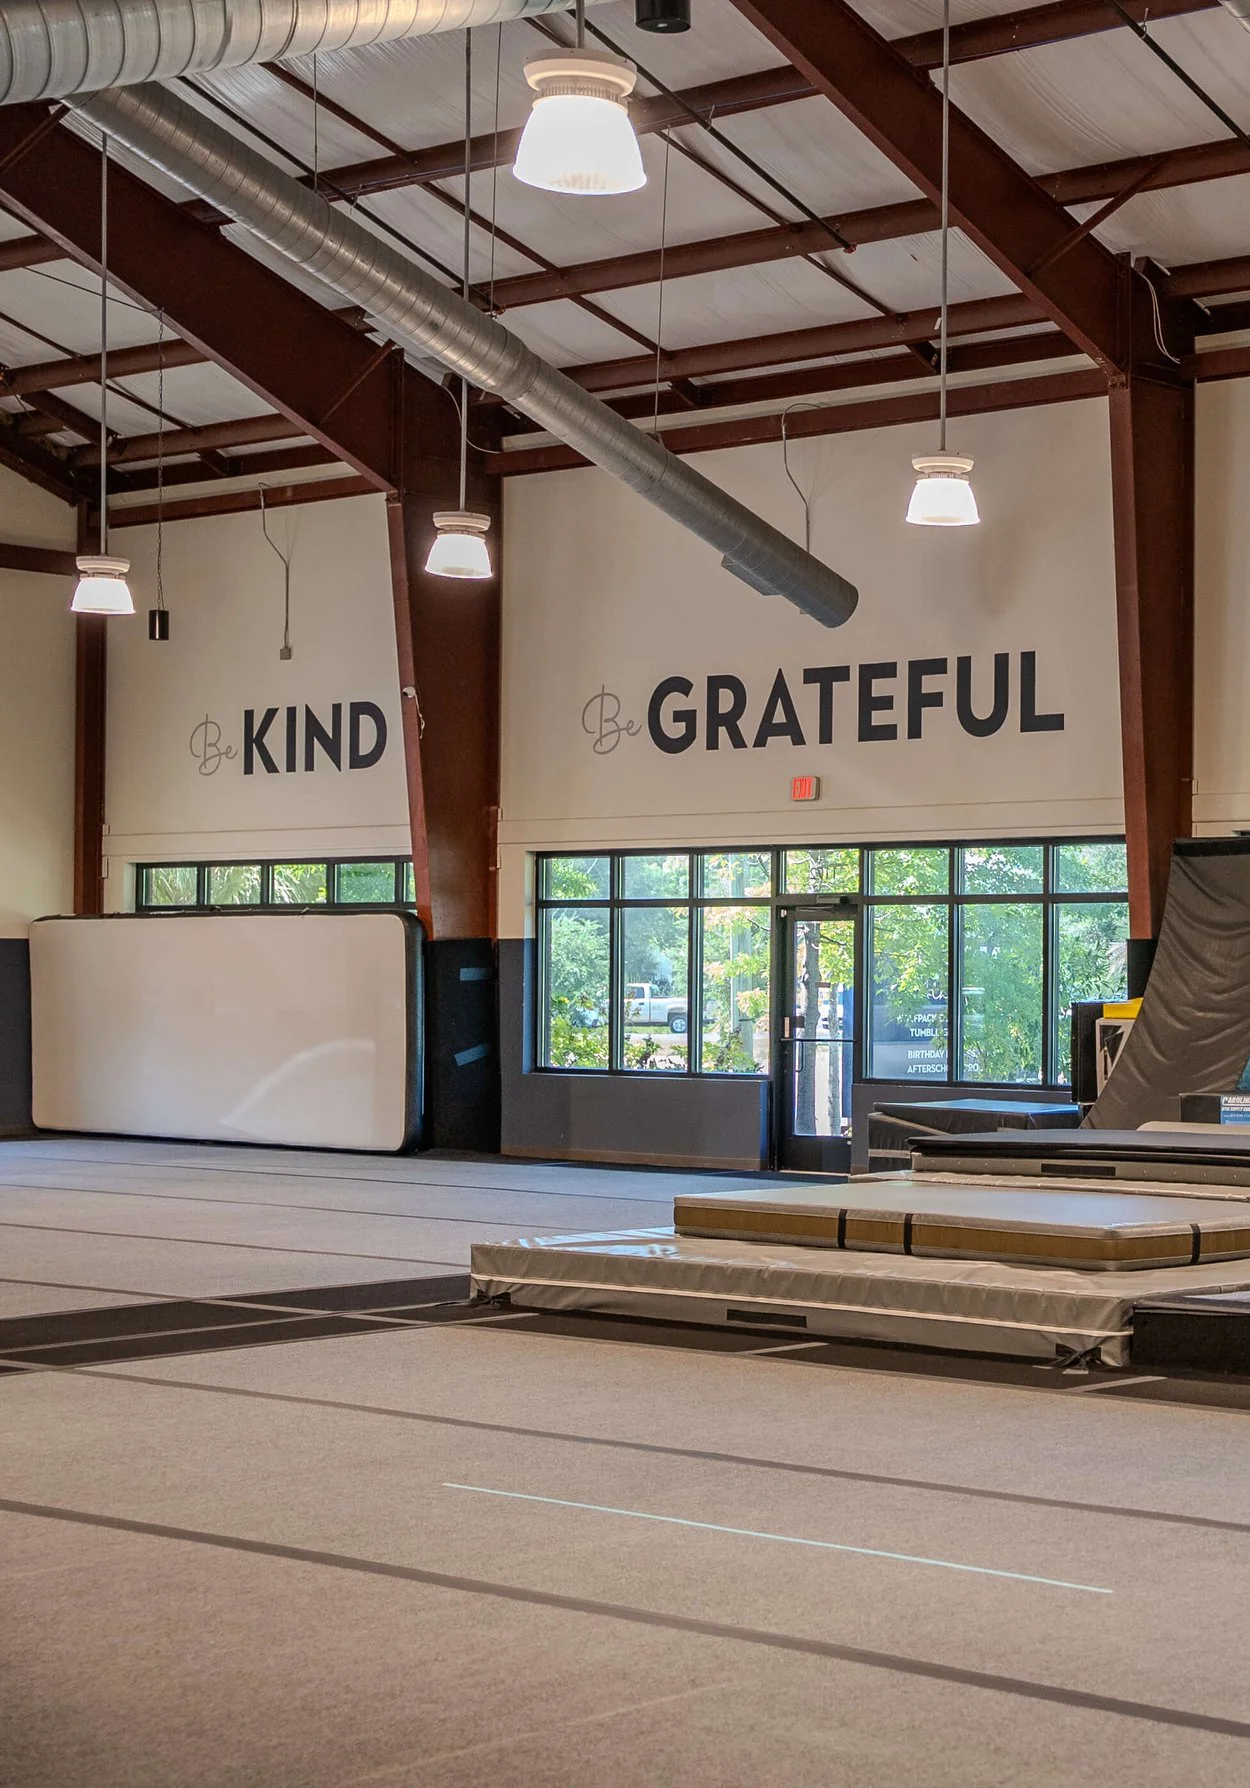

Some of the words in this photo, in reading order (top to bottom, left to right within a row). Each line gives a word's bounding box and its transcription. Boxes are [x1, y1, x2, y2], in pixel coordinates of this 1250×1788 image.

[190, 713, 239, 776] Be
[243, 701, 388, 776] KIND
[581, 684, 643, 755] Be
[647, 650, 1065, 755] GRATEFUL
[907, 1049, 946, 1060] BIRTHDAY
